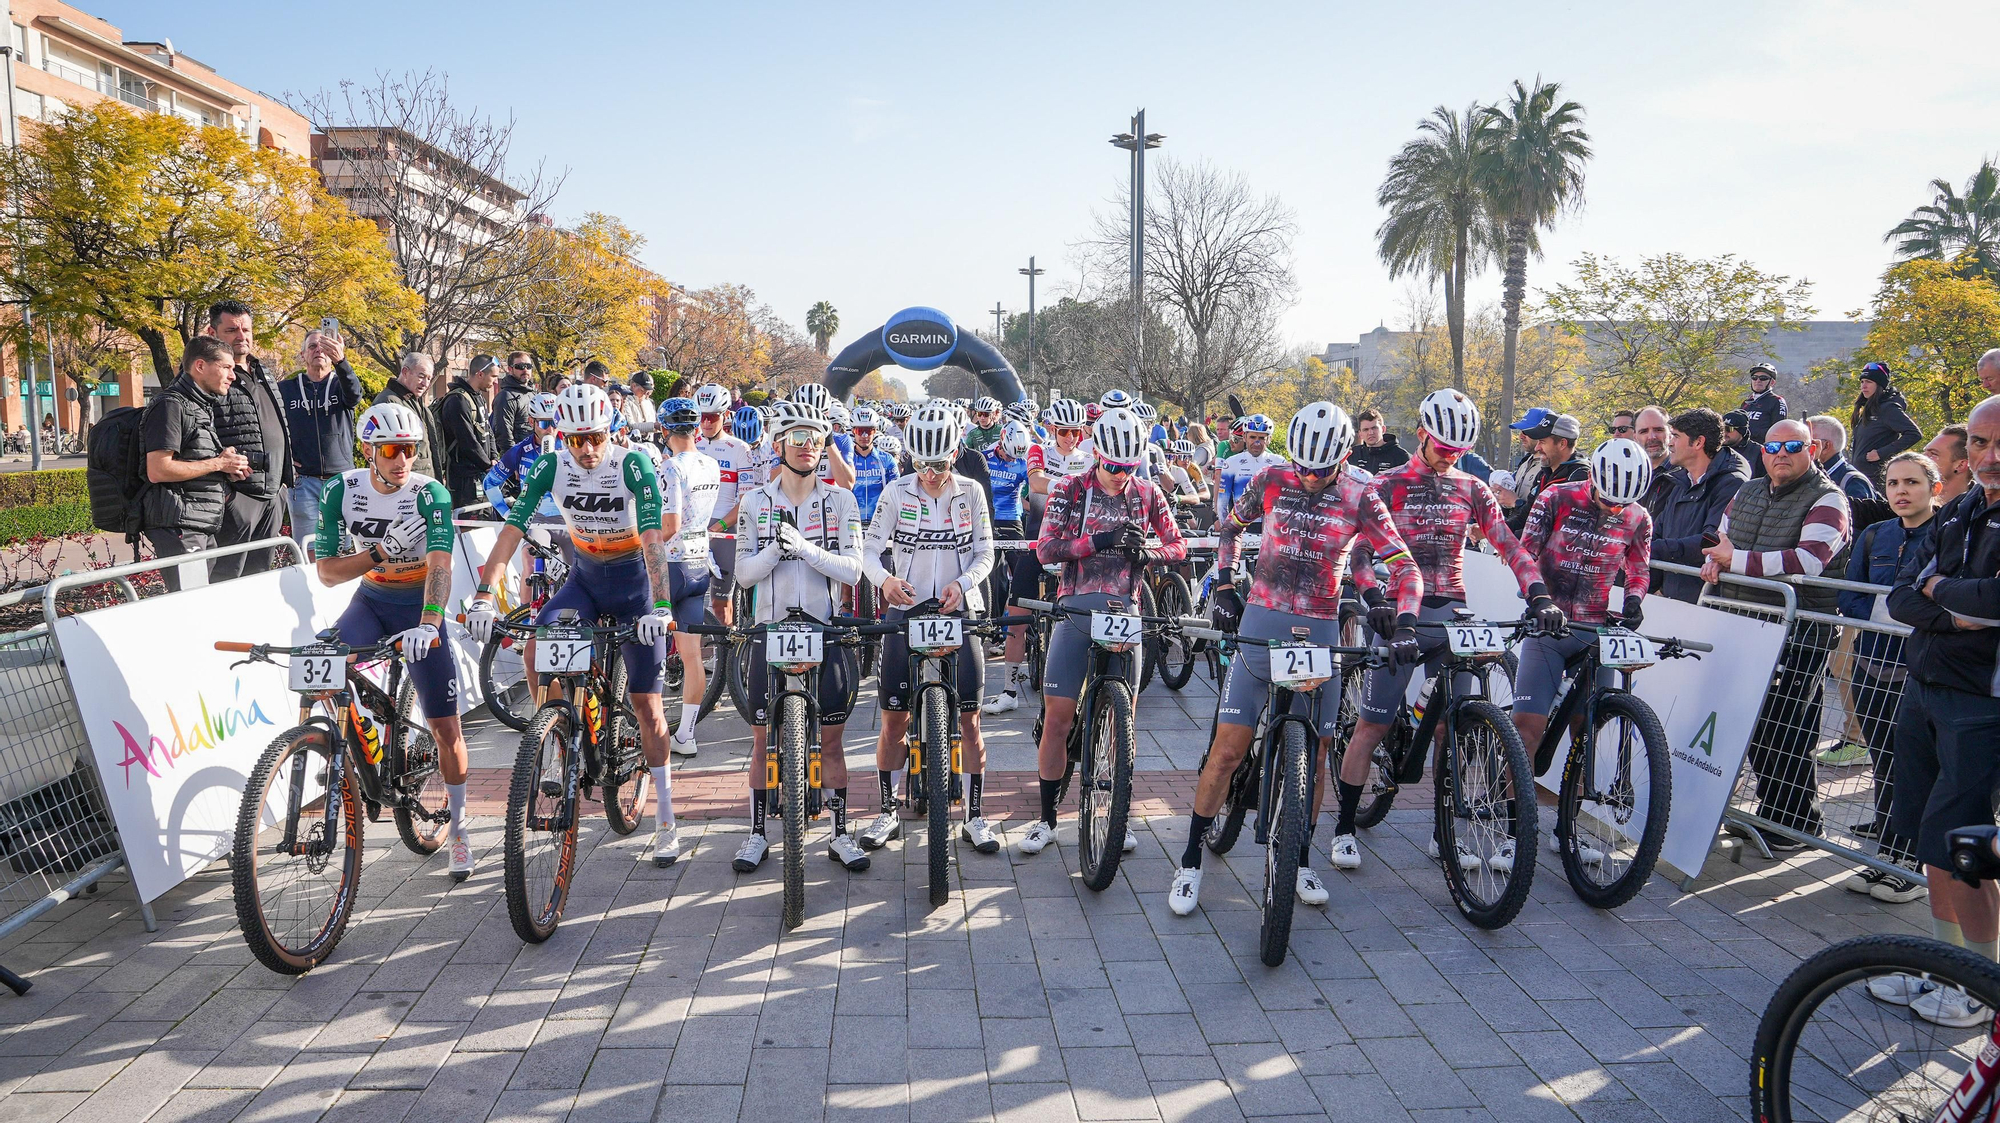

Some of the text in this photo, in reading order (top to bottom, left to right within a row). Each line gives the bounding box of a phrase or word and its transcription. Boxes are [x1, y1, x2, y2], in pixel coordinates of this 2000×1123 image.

[691, 484, 719, 493] SCOTT
[562, 492, 624, 512] KTM
[918, 620, 954, 642] 14-2
[1104, 616, 1129, 638] 2-2
[777, 634, 812, 657] 14-1
[1457, 629, 1496, 648] 21-2
[1608, 638, 1644, 659] 21-1
[550, 642, 575, 666] 3-1
[1286, 650, 1314, 674] 2-1
[304, 658, 332, 684] 3-2
[112, 677, 275, 790] Andalucía
[1671, 748, 1722, 778] Junta de Andalucía
[971, 784, 980, 804] SCOTT
